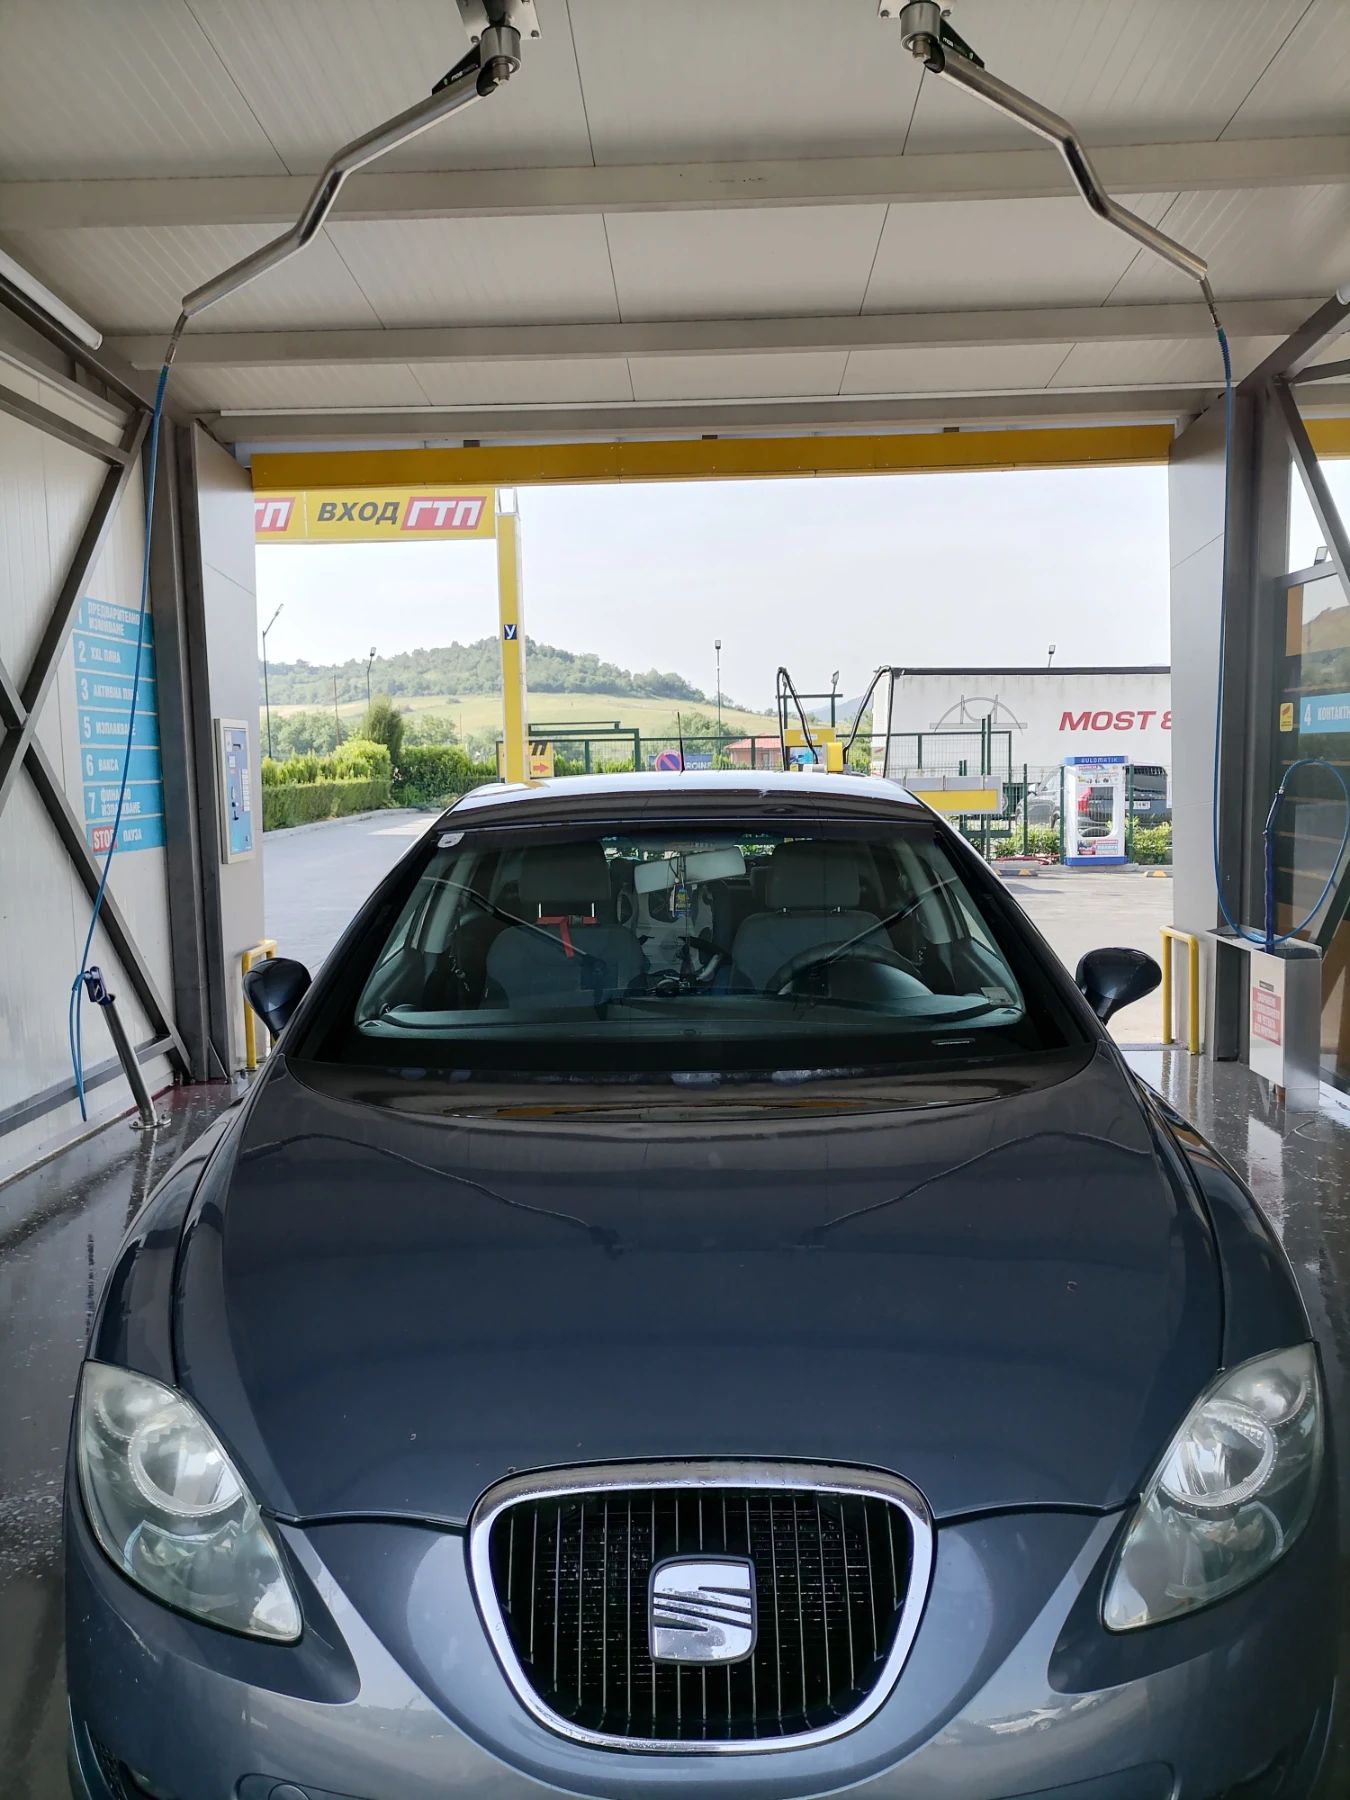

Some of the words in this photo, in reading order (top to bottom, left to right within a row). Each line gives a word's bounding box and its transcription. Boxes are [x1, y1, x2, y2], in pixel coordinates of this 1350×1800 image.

[317, 502, 400, 525] ВХОД
[407, 500, 482, 527] ГТП
[78, 640, 86, 663] 2
[81, 678, 88, 700] 3
[93, 684, 122, 700] АКТИВНА
[1059, 711, 1157, 731] MOST
[1304, 703, 1312, 726] 4
[84, 716, 92, 738] 5
[86, 754, 94, 777] 6
[88, 792, 96, 814] 7
[123, 828, 143, 842] ПАУЗА
